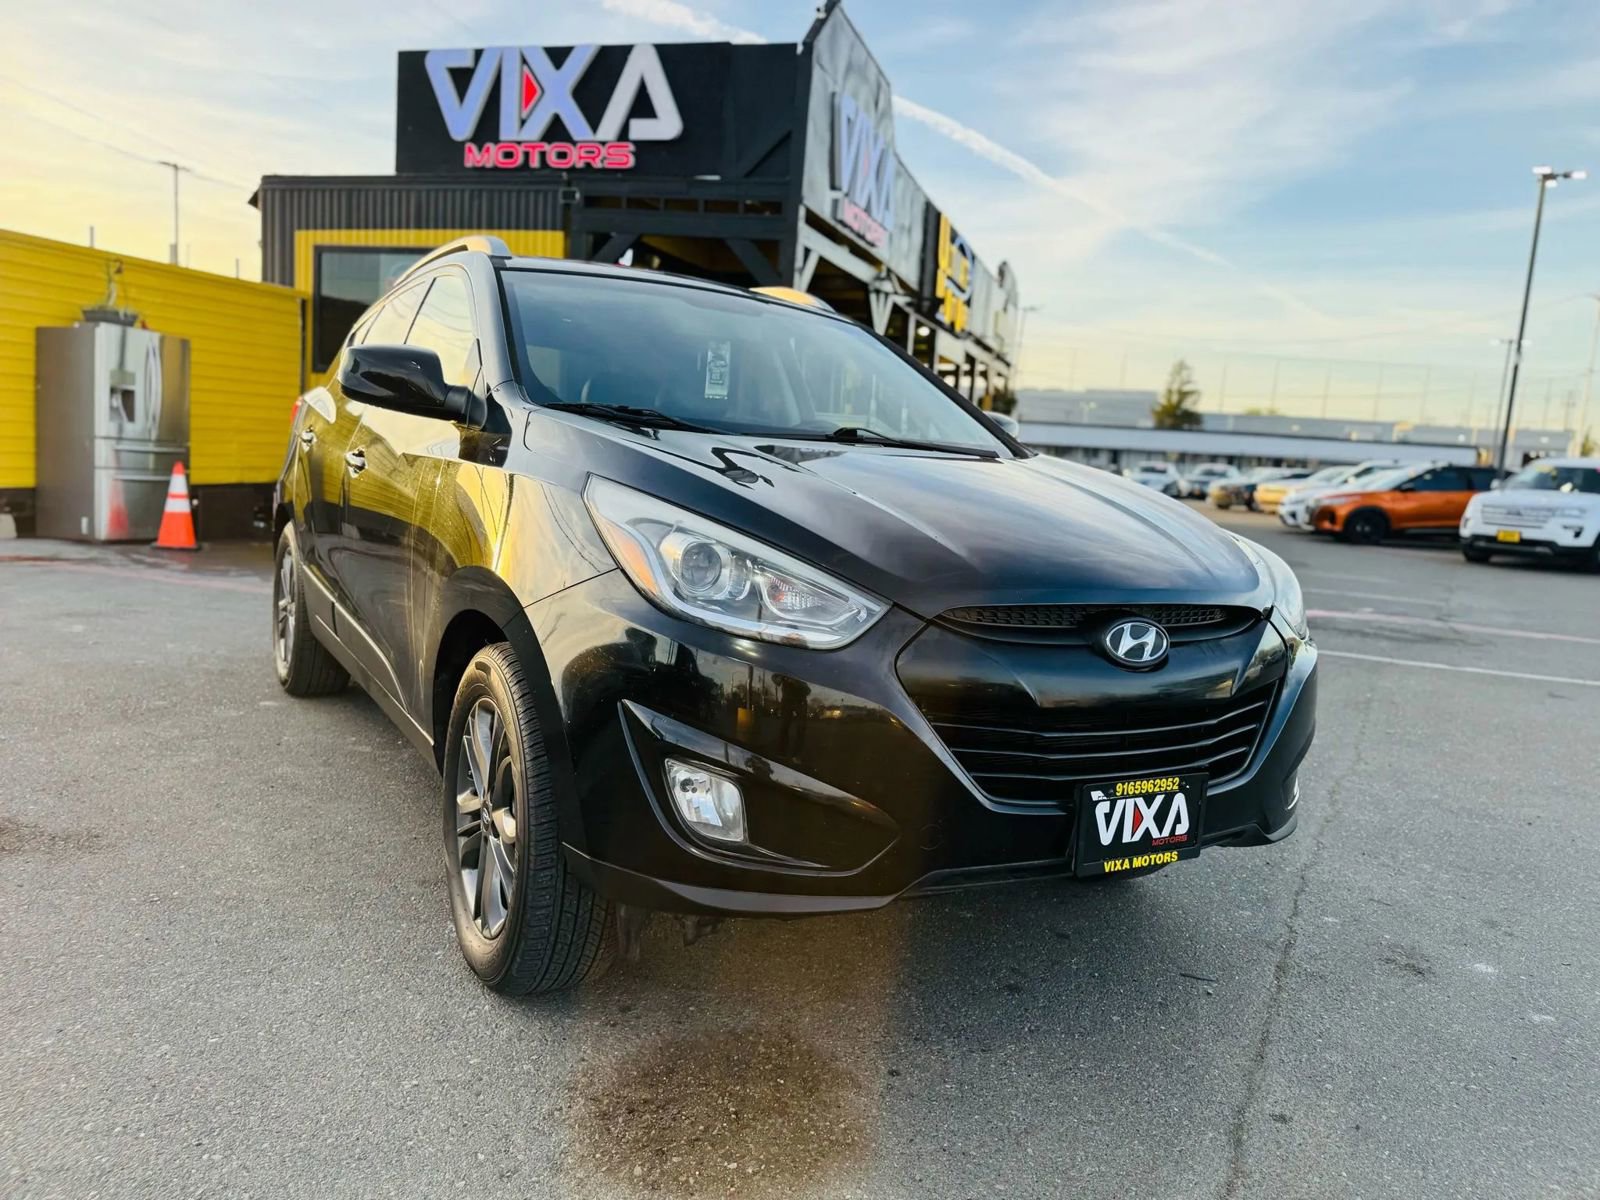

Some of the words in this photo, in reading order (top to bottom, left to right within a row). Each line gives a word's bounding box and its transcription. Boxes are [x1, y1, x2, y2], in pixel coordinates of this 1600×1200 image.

[424, 43, 684, 142] VIXA
[464, 141, 636, 169] MOTORS
[1115, 777, 1180, 796] 9165962952
[1094, 792, 1190, 846] VIXA
[1151, 834, 1188, 847] MOTORS
[1103, 858, 1131, 873] VIXA
[1132, 851, 1179, 869] MOTORS
